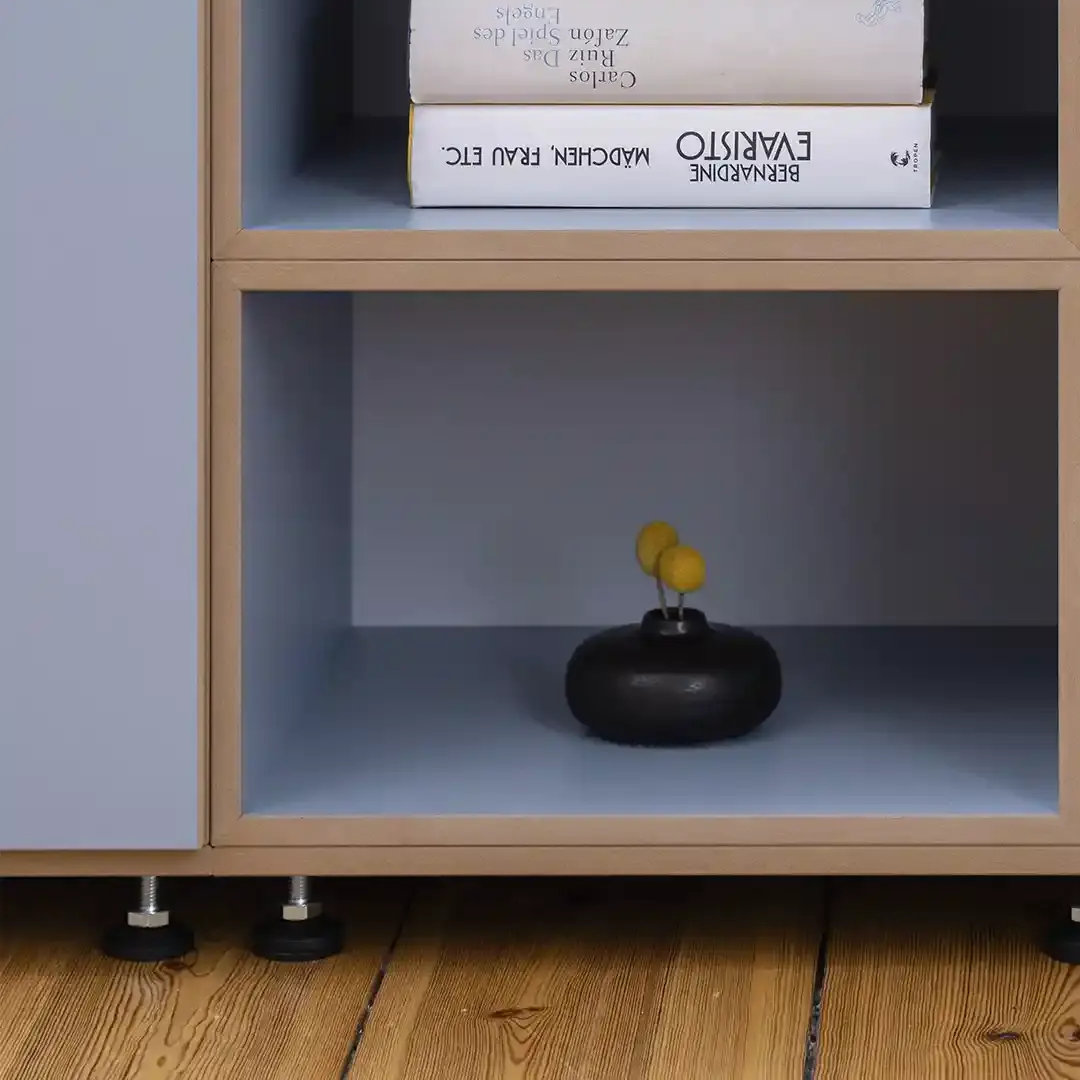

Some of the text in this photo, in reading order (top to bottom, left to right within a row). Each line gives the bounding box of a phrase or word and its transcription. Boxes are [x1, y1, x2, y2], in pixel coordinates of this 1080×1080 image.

[496, 6, 560, 25] Engels
[473, 25, 560, 46] Spiel des
[569, 26, 630, 46] Zafón
[523, 49, 559, 68] Das
[569, 49, 615, 68] Ruiz
[569, 70, 636, 89] Carlos
[676, 131, 811, 161] EVARISTO
[441, 145, 650, 169] MÄDCHEN, FRAU ETC.
[689, 164, 800, 183] BERNARDINE
